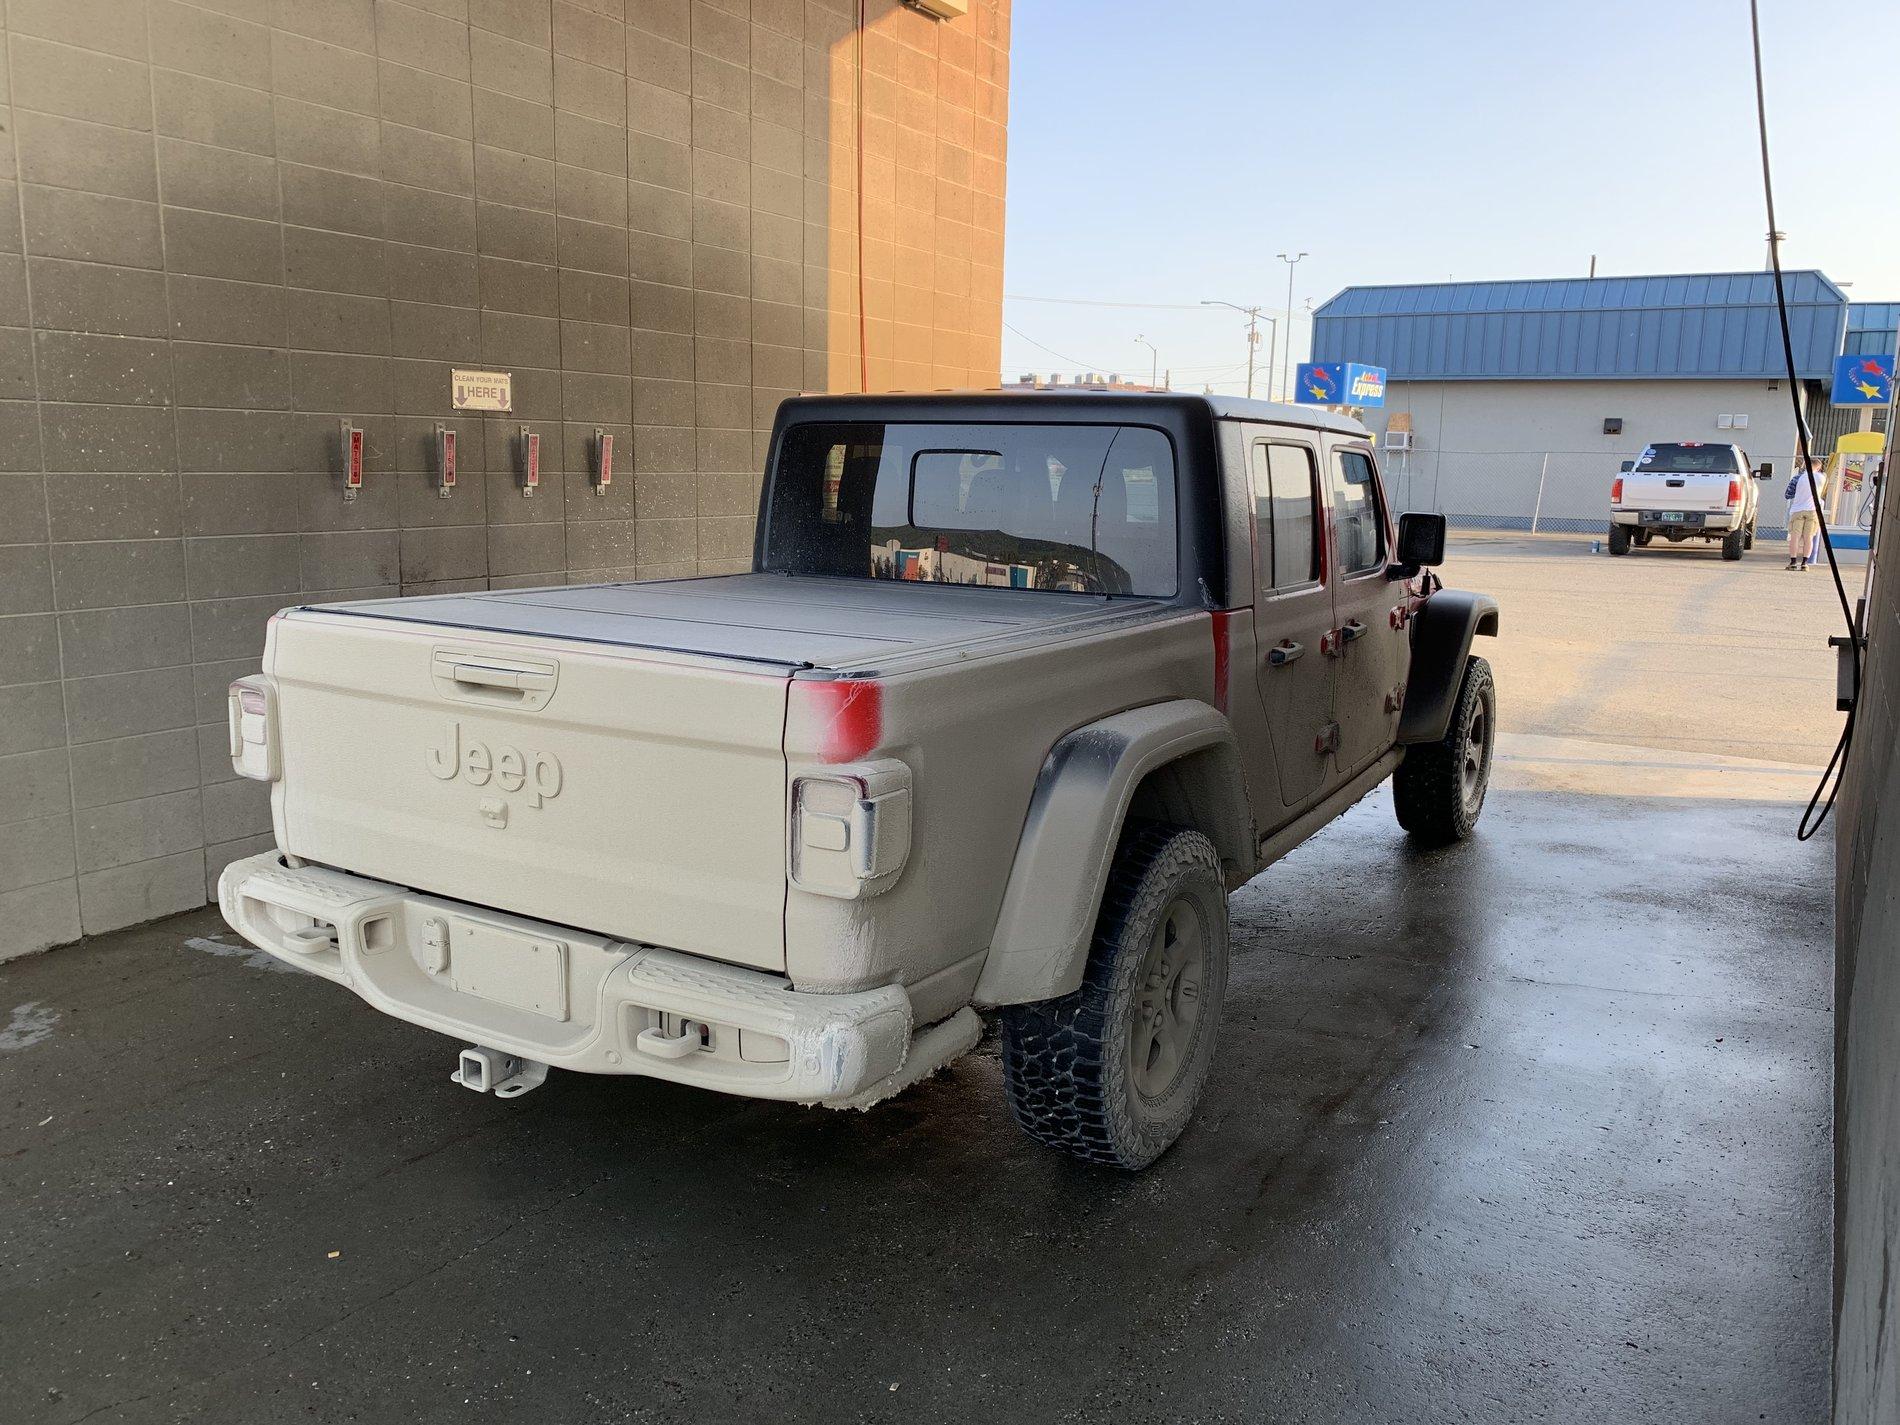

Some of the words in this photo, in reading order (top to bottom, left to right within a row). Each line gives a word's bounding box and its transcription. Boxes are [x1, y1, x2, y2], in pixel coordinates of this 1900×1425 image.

[454, 374, 475, 382] CLEAN
[467, 386, 498, 399] HERE
[1352, 376, 1384, 400] Express
[426, 720, 563, 809] Jeep
